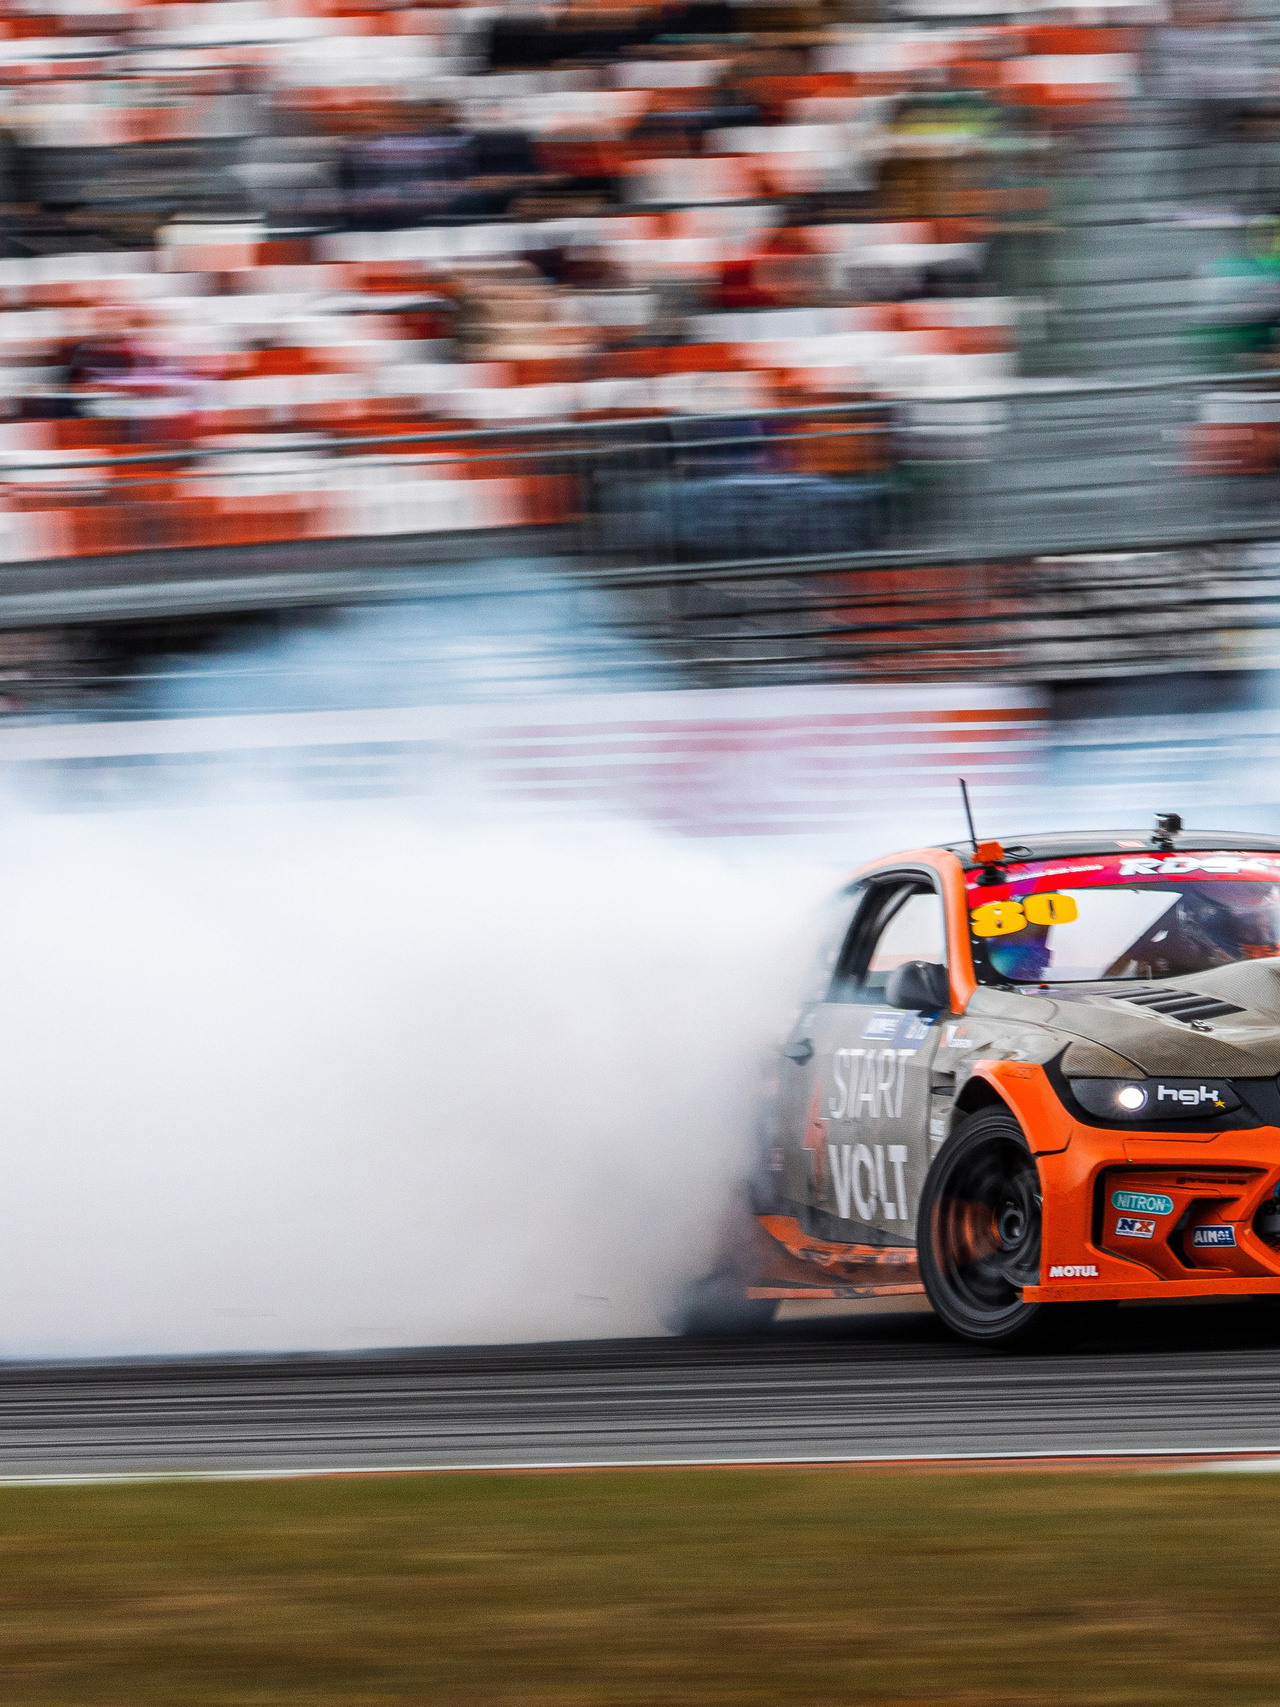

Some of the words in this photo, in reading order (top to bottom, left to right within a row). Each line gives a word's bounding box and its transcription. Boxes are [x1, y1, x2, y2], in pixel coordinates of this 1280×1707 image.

[1118, 856, 1243, 876] RDS
[971, 894, 1078, 938] 80
[828, 1048, 917, 1119] START
[1157, 1085, 1219, 1106] hgk
[827, 1144, 909, 1220] VOLT
[1117, 1193, 1167, 1212] NITRON
[1118, 1218, 1154, 1232] NX
[1194, 1230, 1234, 1243] AIMOL
[1049, 1265, 1099, 1278] MOTUL
